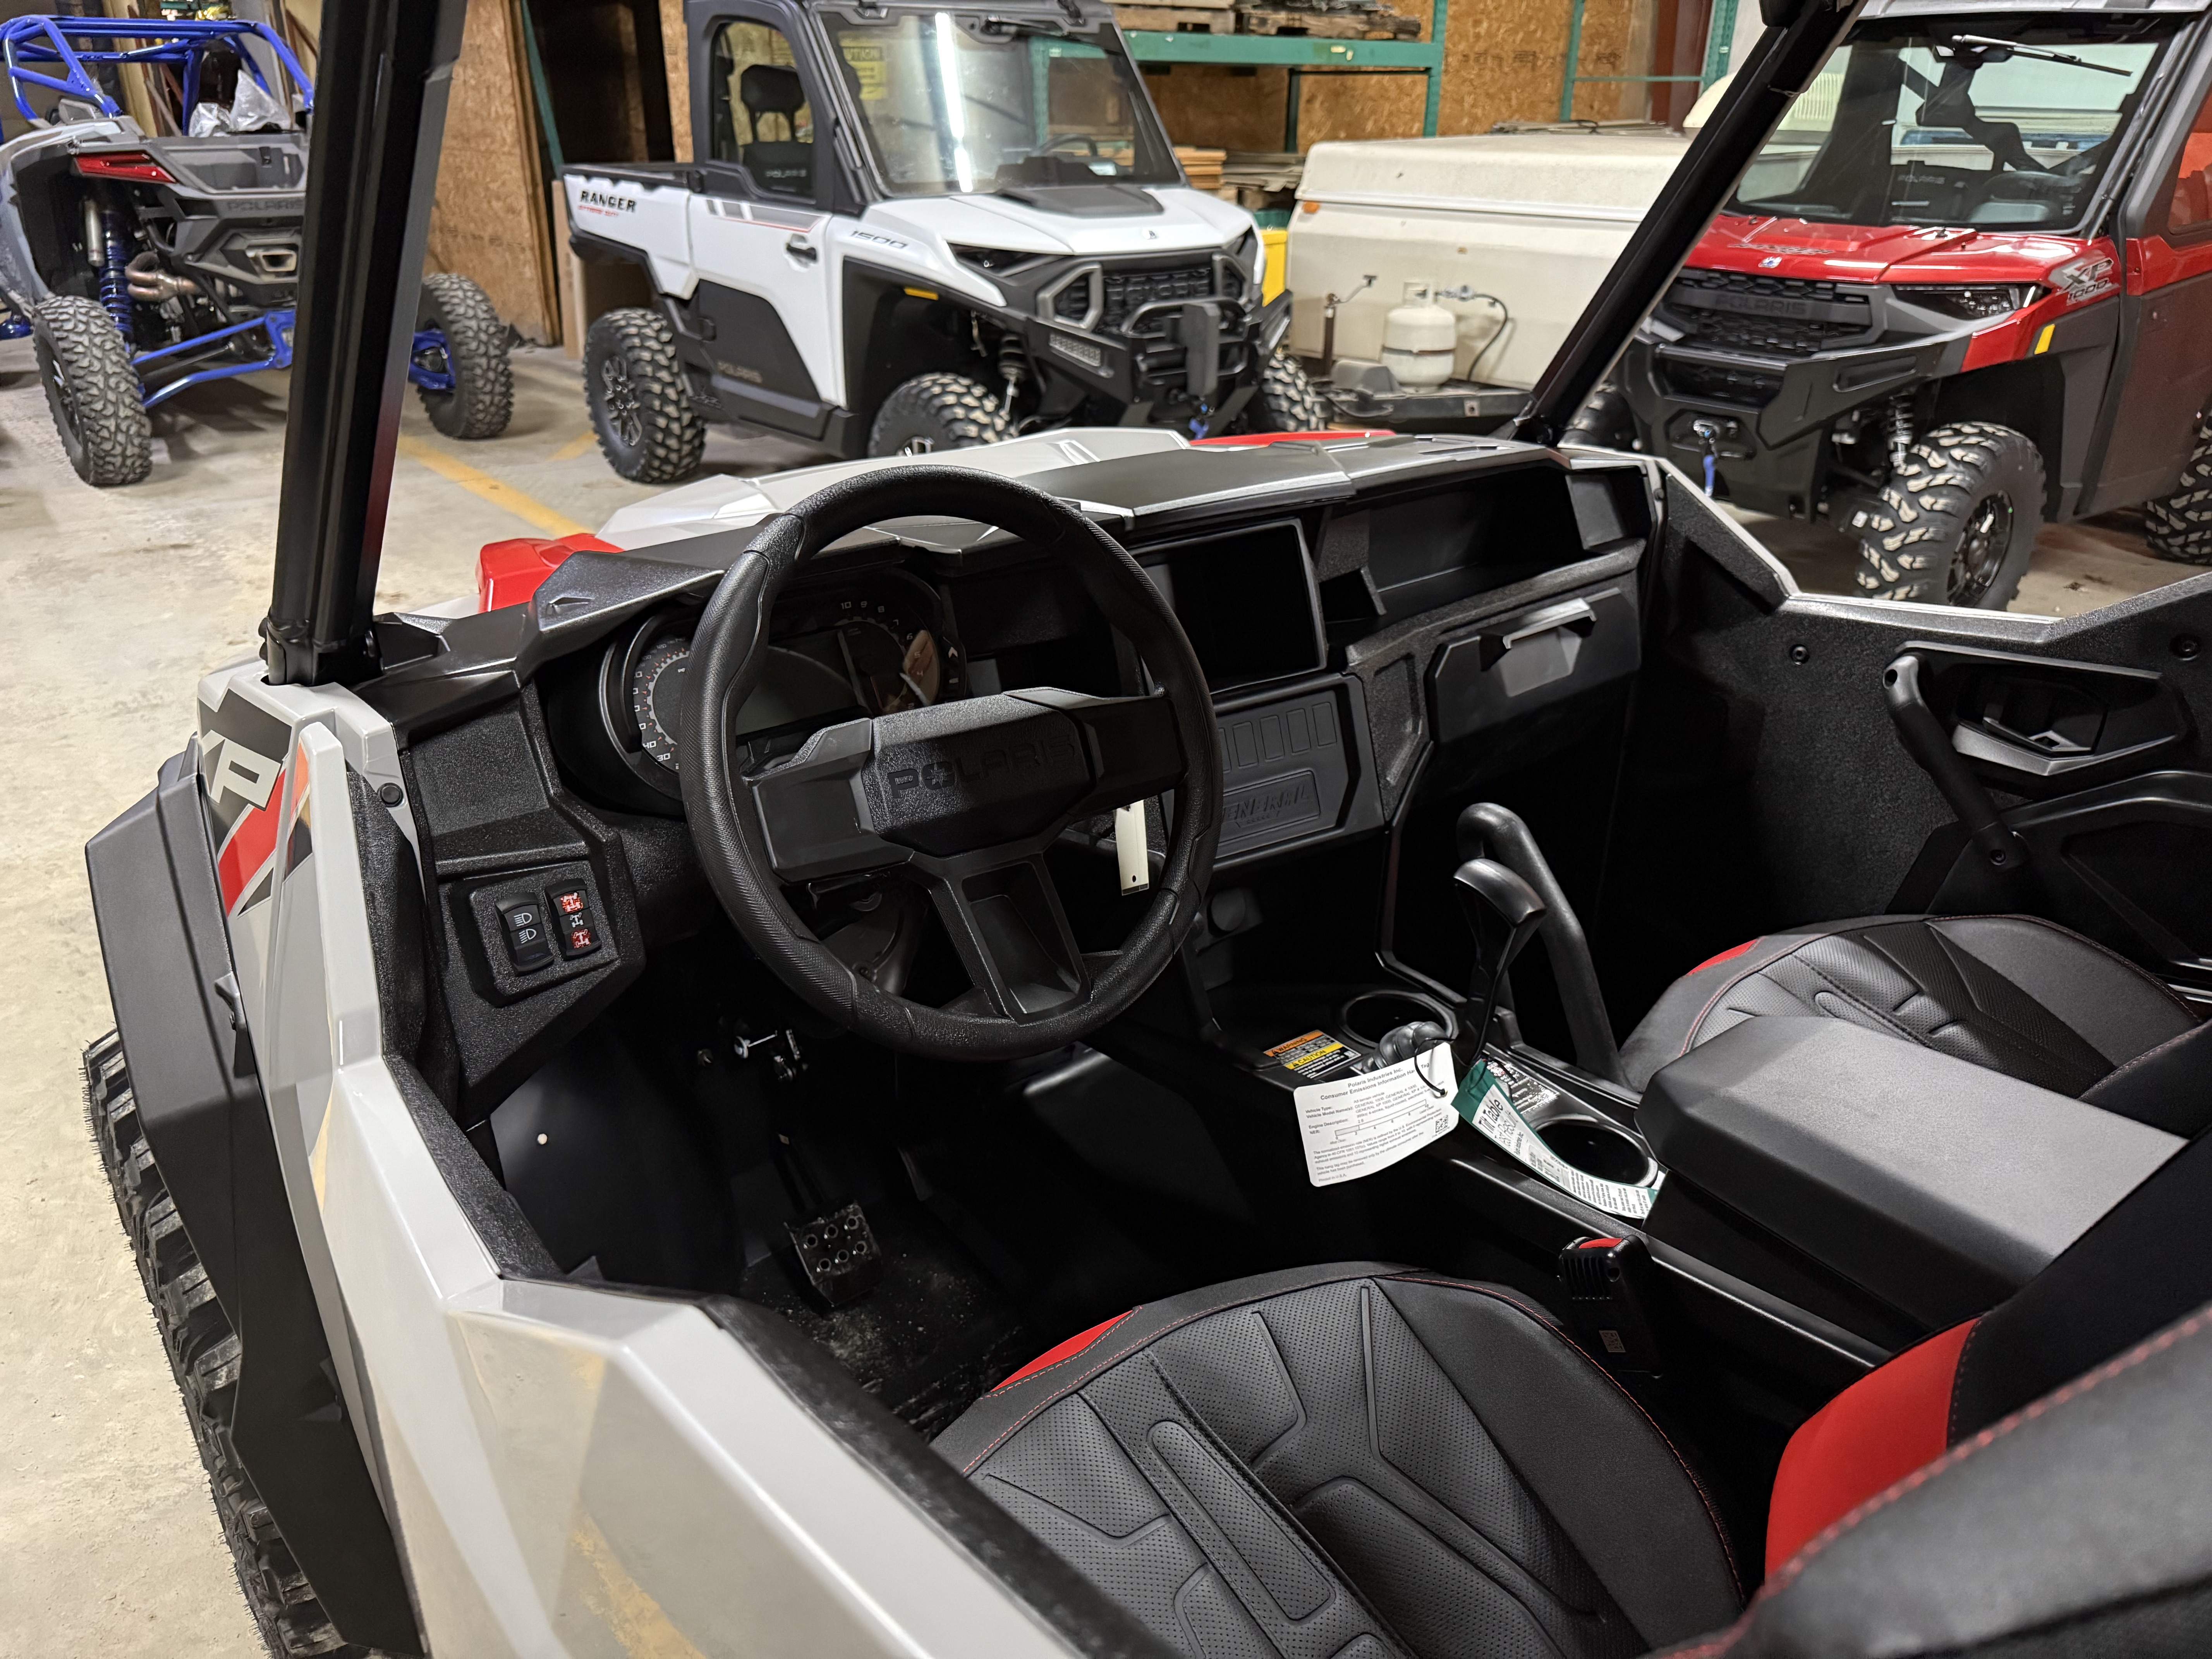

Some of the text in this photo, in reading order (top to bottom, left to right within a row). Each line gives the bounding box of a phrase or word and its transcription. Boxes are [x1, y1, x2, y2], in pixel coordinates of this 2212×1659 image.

[580, 190, 637, 213] RANGER
[851, 231, 908, 249] 1500
[2064, 258, 2113, 290] XP
[2068, 279, 2109, 300] 1000
[840, 601, 852, 610] 10
[643, 740, 656, 749] 40
[657, 753, 671, 762] 30
[888, 735, 1075, 799] POLARIS
[1298, 1049, 1326, 1064] CAUTION
[1320, 1091, 1348, 1100] Consumer
[1349, 1083, 1377, 1094] Emissions
[1377, 1073, 1407, 1086] Information
[1348, 1080, 1366, 1088] Polaris
[1367, 1072, 1393, 1082] Industries
[1386, 1090, 1403, 1099] GENERAL
[1393, 1092, 1410, 1101] GENERAL
[1479, 1099, 1503, 1134] Tilt Table
